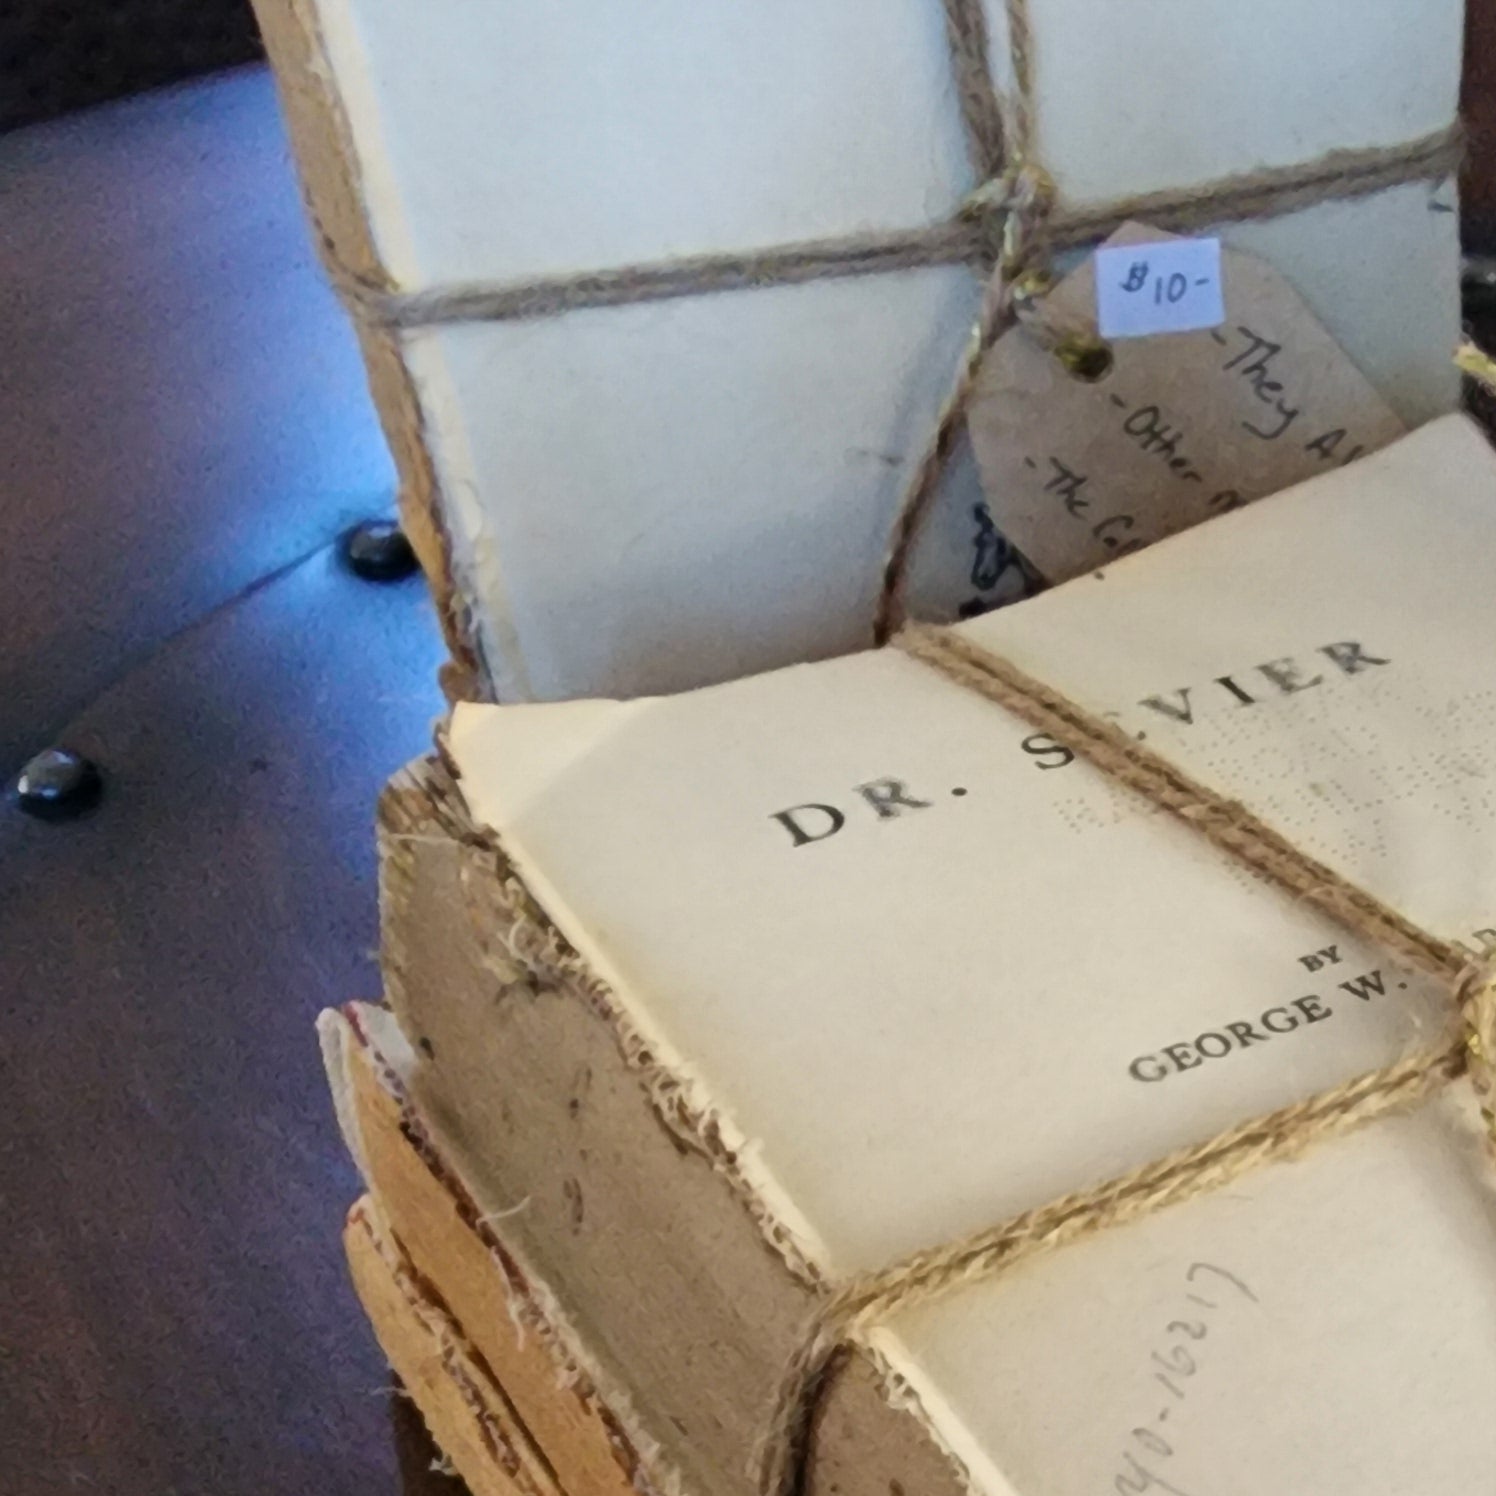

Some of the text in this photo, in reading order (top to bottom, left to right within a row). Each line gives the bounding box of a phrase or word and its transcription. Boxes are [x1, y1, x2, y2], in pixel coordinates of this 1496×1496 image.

[768, 640, 1392, 849] DR. SVIER
[1299, 944, 1344, 974] BY
[1128, 969, 1408, 1085] GEORGE W.
